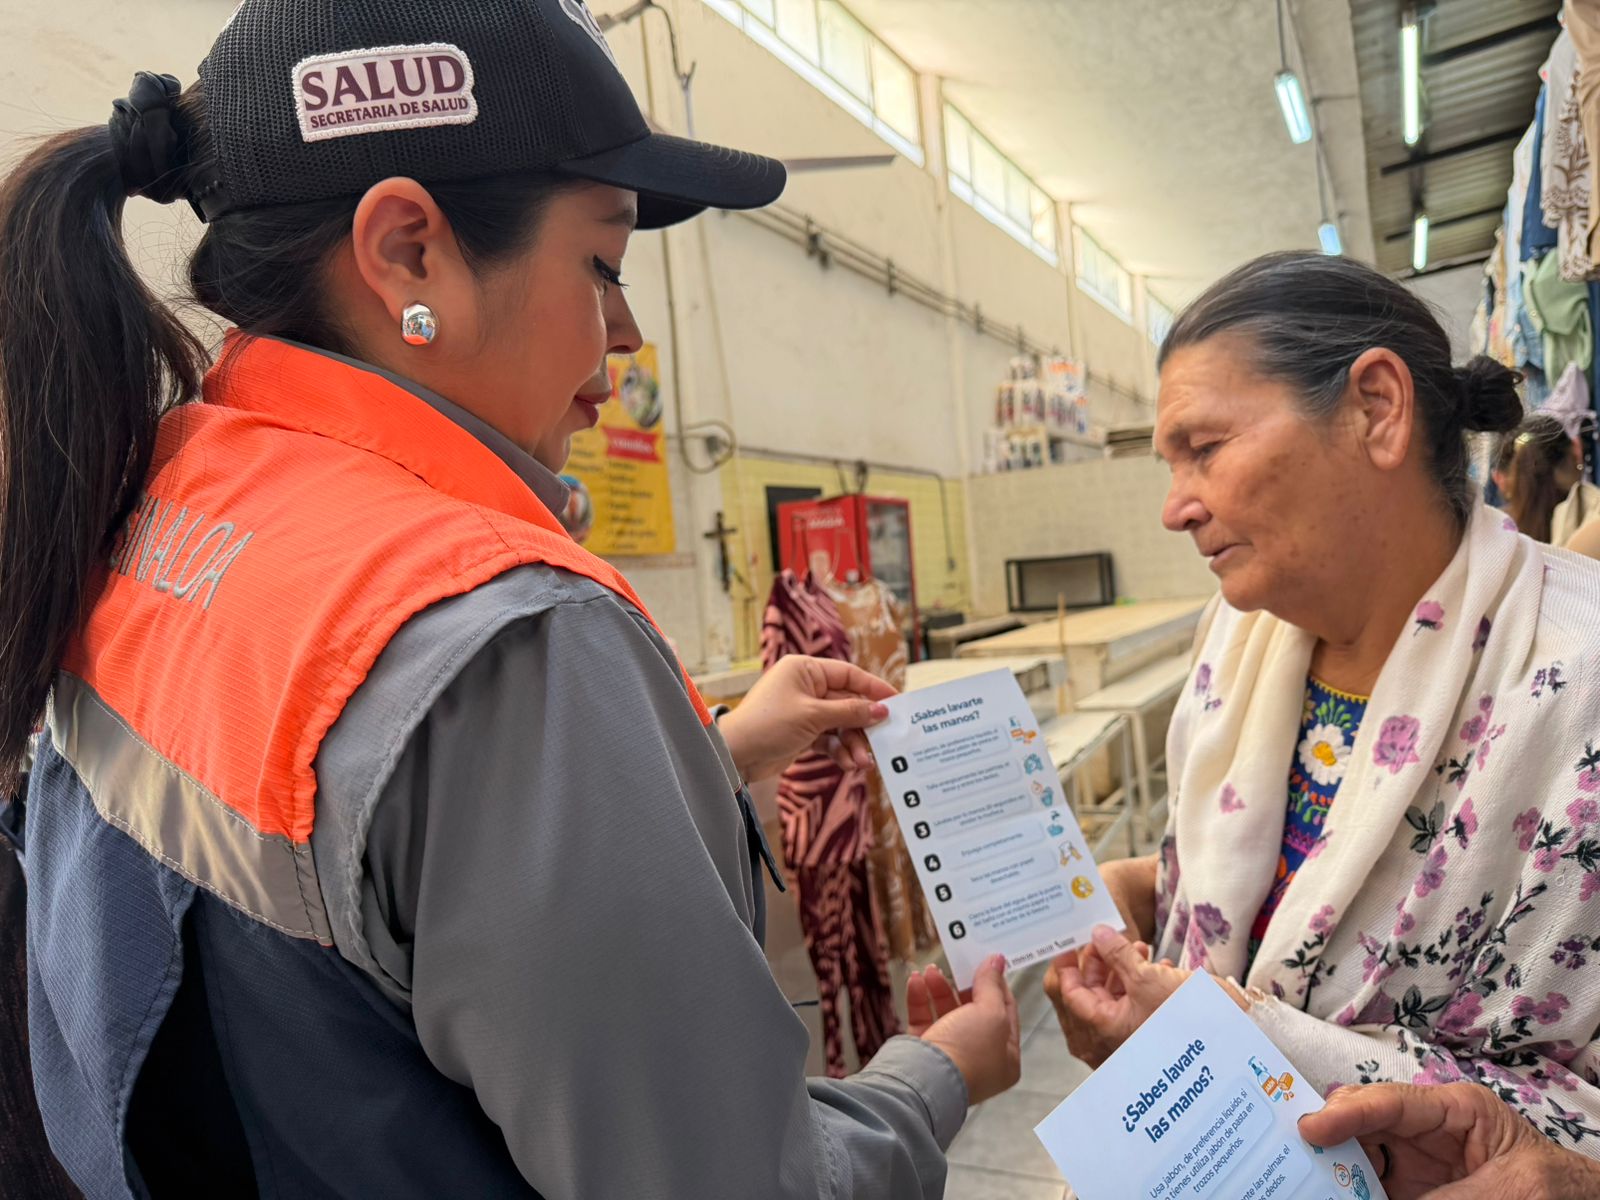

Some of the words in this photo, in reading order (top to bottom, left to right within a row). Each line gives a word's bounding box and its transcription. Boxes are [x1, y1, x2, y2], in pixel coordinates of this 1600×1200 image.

[301, 55, 465, 111] SALUD
[310, 104, 398, 128] SECRETARIA
[400, 101, 420, 115] DE
[422, 97, 468, 113] SALUD
[911, 707, 947, 724] ¿Sabes
[947, 697, 983, 712] lavarte
[922, 722, 939, 733] las
[940, 710, 980, 729] manos?
[1122, 1078, 1168, 1132] ¿Sabes
[1162, 1039, 1205, 1083] lavarte
[1144, 1117, 1170, 1143] las
[1167, 1065, 1214, 1122] manos?
[1149, 1183, 1165, 1198] Usa
[1184, 1151, 1193, 1164] de
[1192, 1118, 1225, 1156] preferencia
[1241, 1088, 1248, 1098] si
[1169, 1175, 1191, 1198] tienes
[1191, 1154, 1210, 1177] utiliza
[1208, 1137, 1223, 1160] jabón
[1224, 1127, 1234, 1139] de
[1231, 1110, 1248, 1133] pasta
[1246, 1102, 1254, 1112] en
[1193, 1171, 1215, 1193] trozos
[1214, 1136, 1244, 1175] pequeños.
[1252, 1177, 1265, 1190] las
[1263, 1156, 1286, 1182] palmas,
[1283, 1144, 1290, 1155] el
[1265, 1174, 1287, 1197] dedos.
